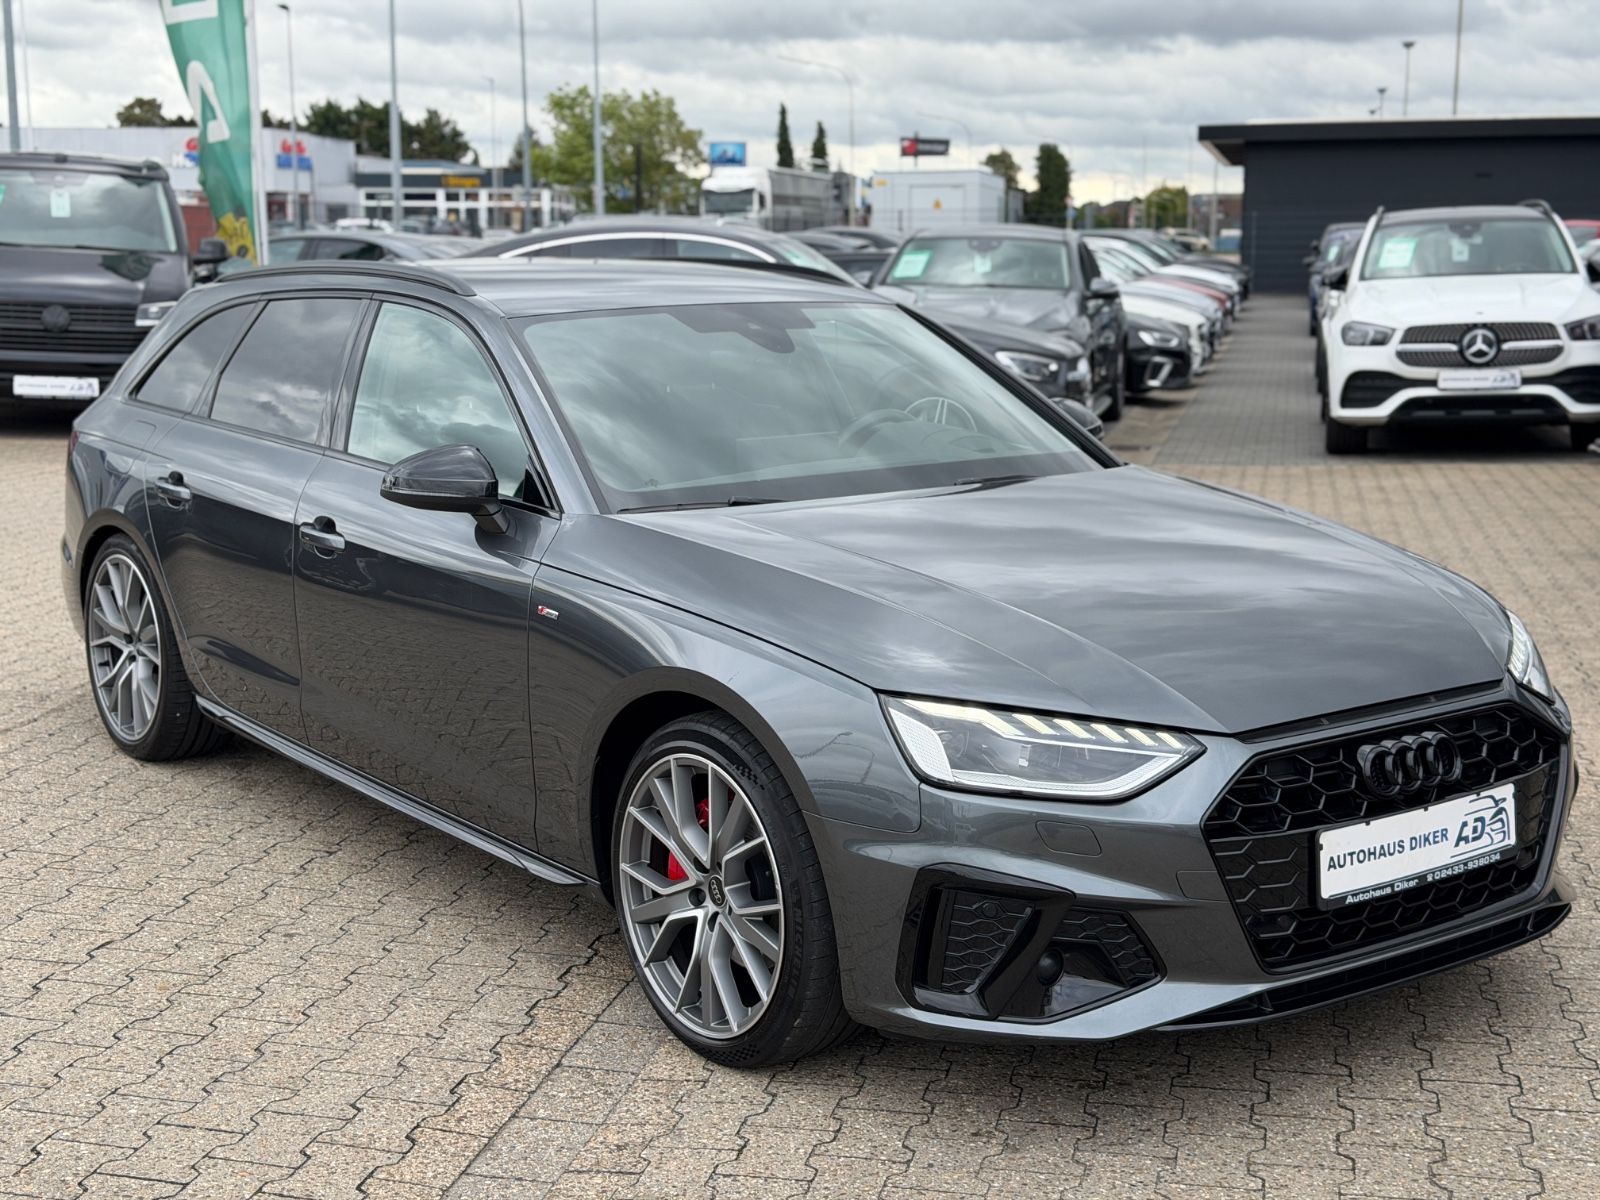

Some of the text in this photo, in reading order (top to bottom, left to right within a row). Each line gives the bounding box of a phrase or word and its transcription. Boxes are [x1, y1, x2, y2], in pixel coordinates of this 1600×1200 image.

[1326, 827, 1449, 872] AUTOHAUS DIKER
[1344, 885, 1392, 905] Autohaus
[1393, 878, 1420, 892] Diker
